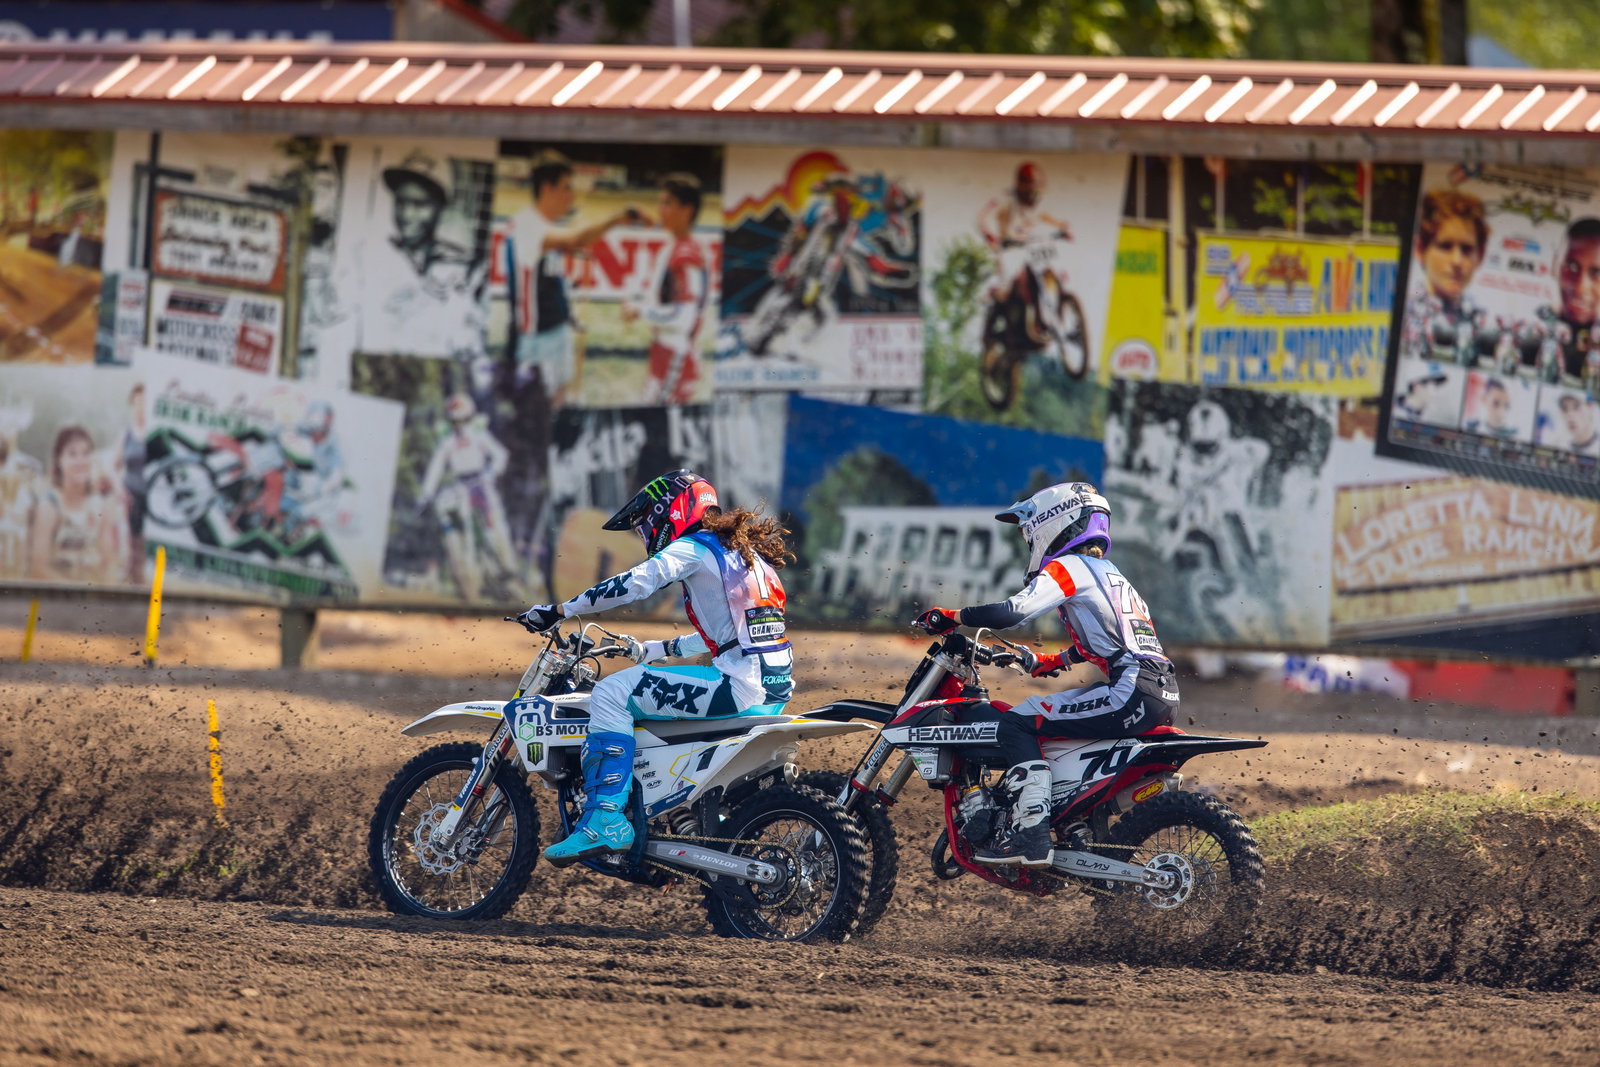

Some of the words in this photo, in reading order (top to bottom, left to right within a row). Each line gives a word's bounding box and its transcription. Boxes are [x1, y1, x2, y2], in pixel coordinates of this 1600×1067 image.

[646, 491, 675, 528] FOX
[1031, 493, 1093, 528] HEATWAVE
[1338, 488, 1491, 563] LORETTA
[1507, 488, 1596, 541] LYNN
[655, 523, 670, 552] MONSTER
[1367, 530, 1450, 586] DUDE
[1461, 522, 1566, 564] RANCH
[631, 671, 709, 715] FOX
[1123, 700, 1146, 729] FLY
[908, 727, 996, 742] HEATWAVE
[695, 744, 720, 773] 1
[1079, 745, 1134, 785] 70
[699, 855, 738, 869] DUNLOP
